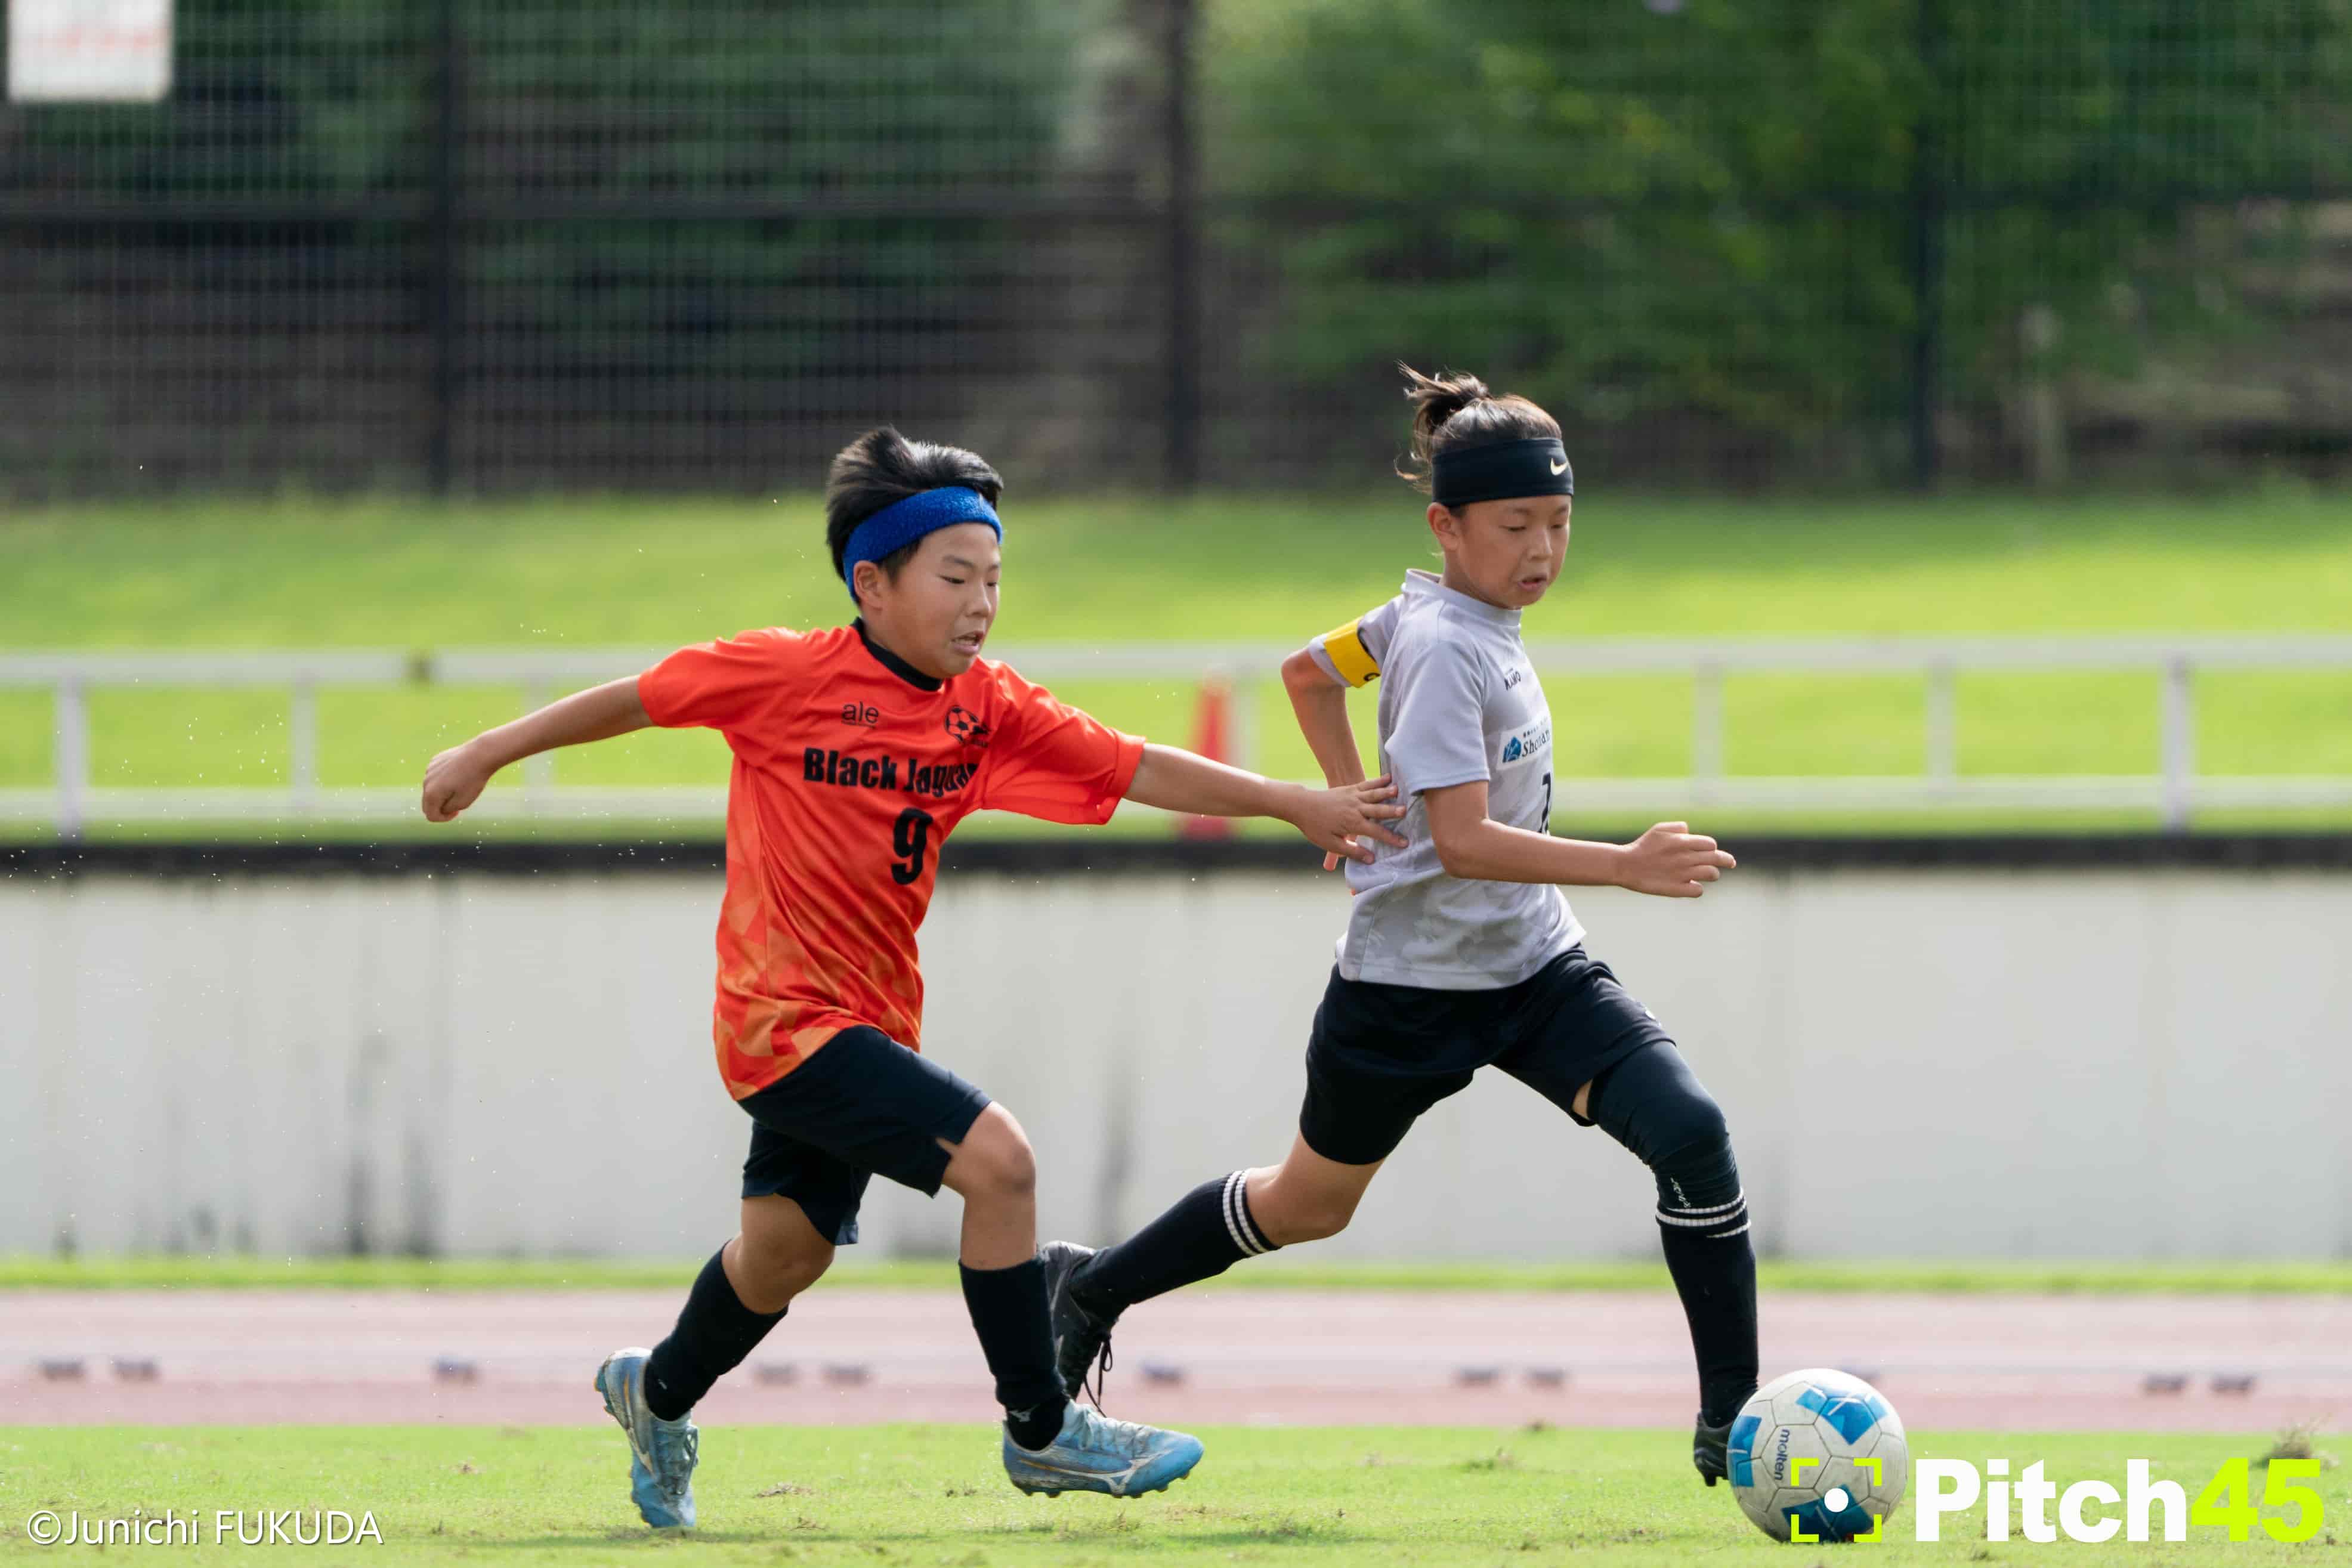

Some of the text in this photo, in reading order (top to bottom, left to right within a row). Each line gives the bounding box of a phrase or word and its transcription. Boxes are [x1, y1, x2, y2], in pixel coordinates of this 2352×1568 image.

[803, 747, 897, 790] Black
[891, 808, 934, 885] 9
[1774, 1428, 1790, 1481] molten
